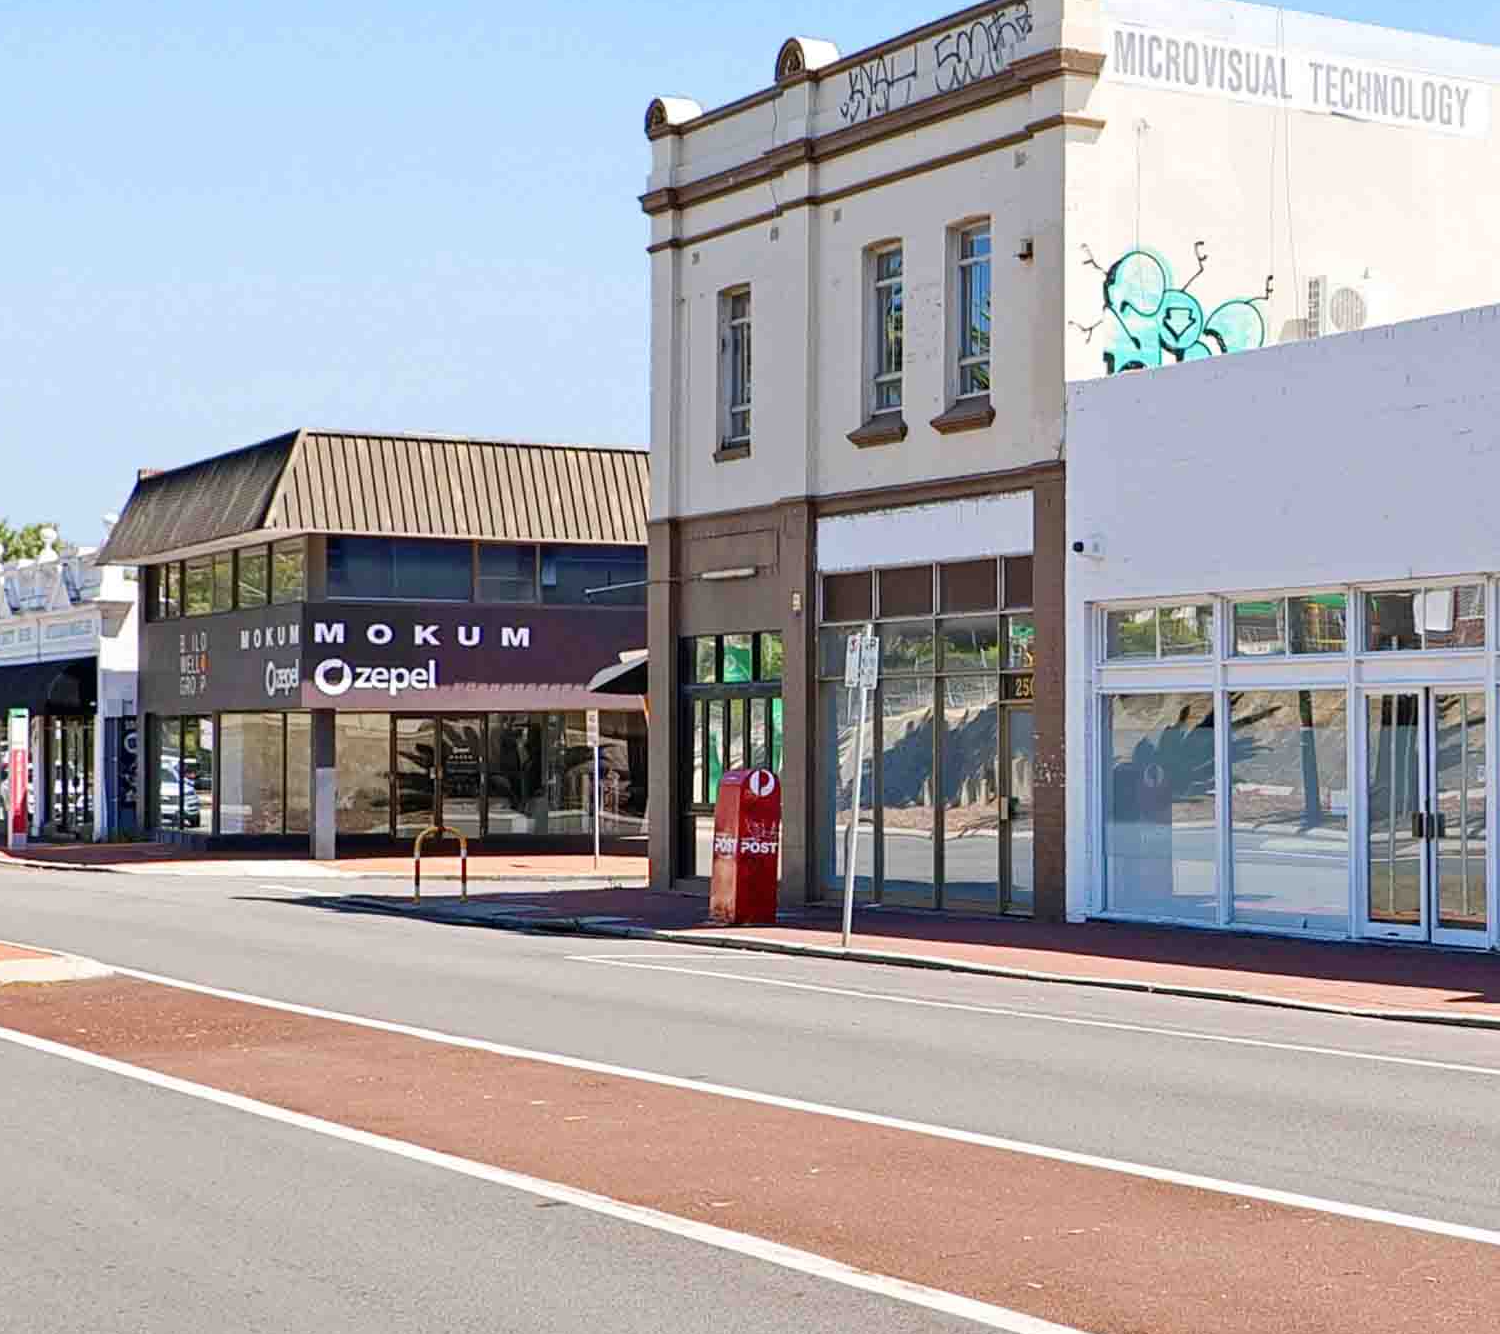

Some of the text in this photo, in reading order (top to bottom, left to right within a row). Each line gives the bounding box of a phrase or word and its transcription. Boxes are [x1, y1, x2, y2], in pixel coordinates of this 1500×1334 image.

[1113, 29, 1293, 100] MICROVISUAL
[1307, 61, 1471, 128] TECHNOLOGY
[239, 623, 300, 651] MOKUM
[314, 622, 530, 648] MOKUM
[740, 841, 778, 855] POST
